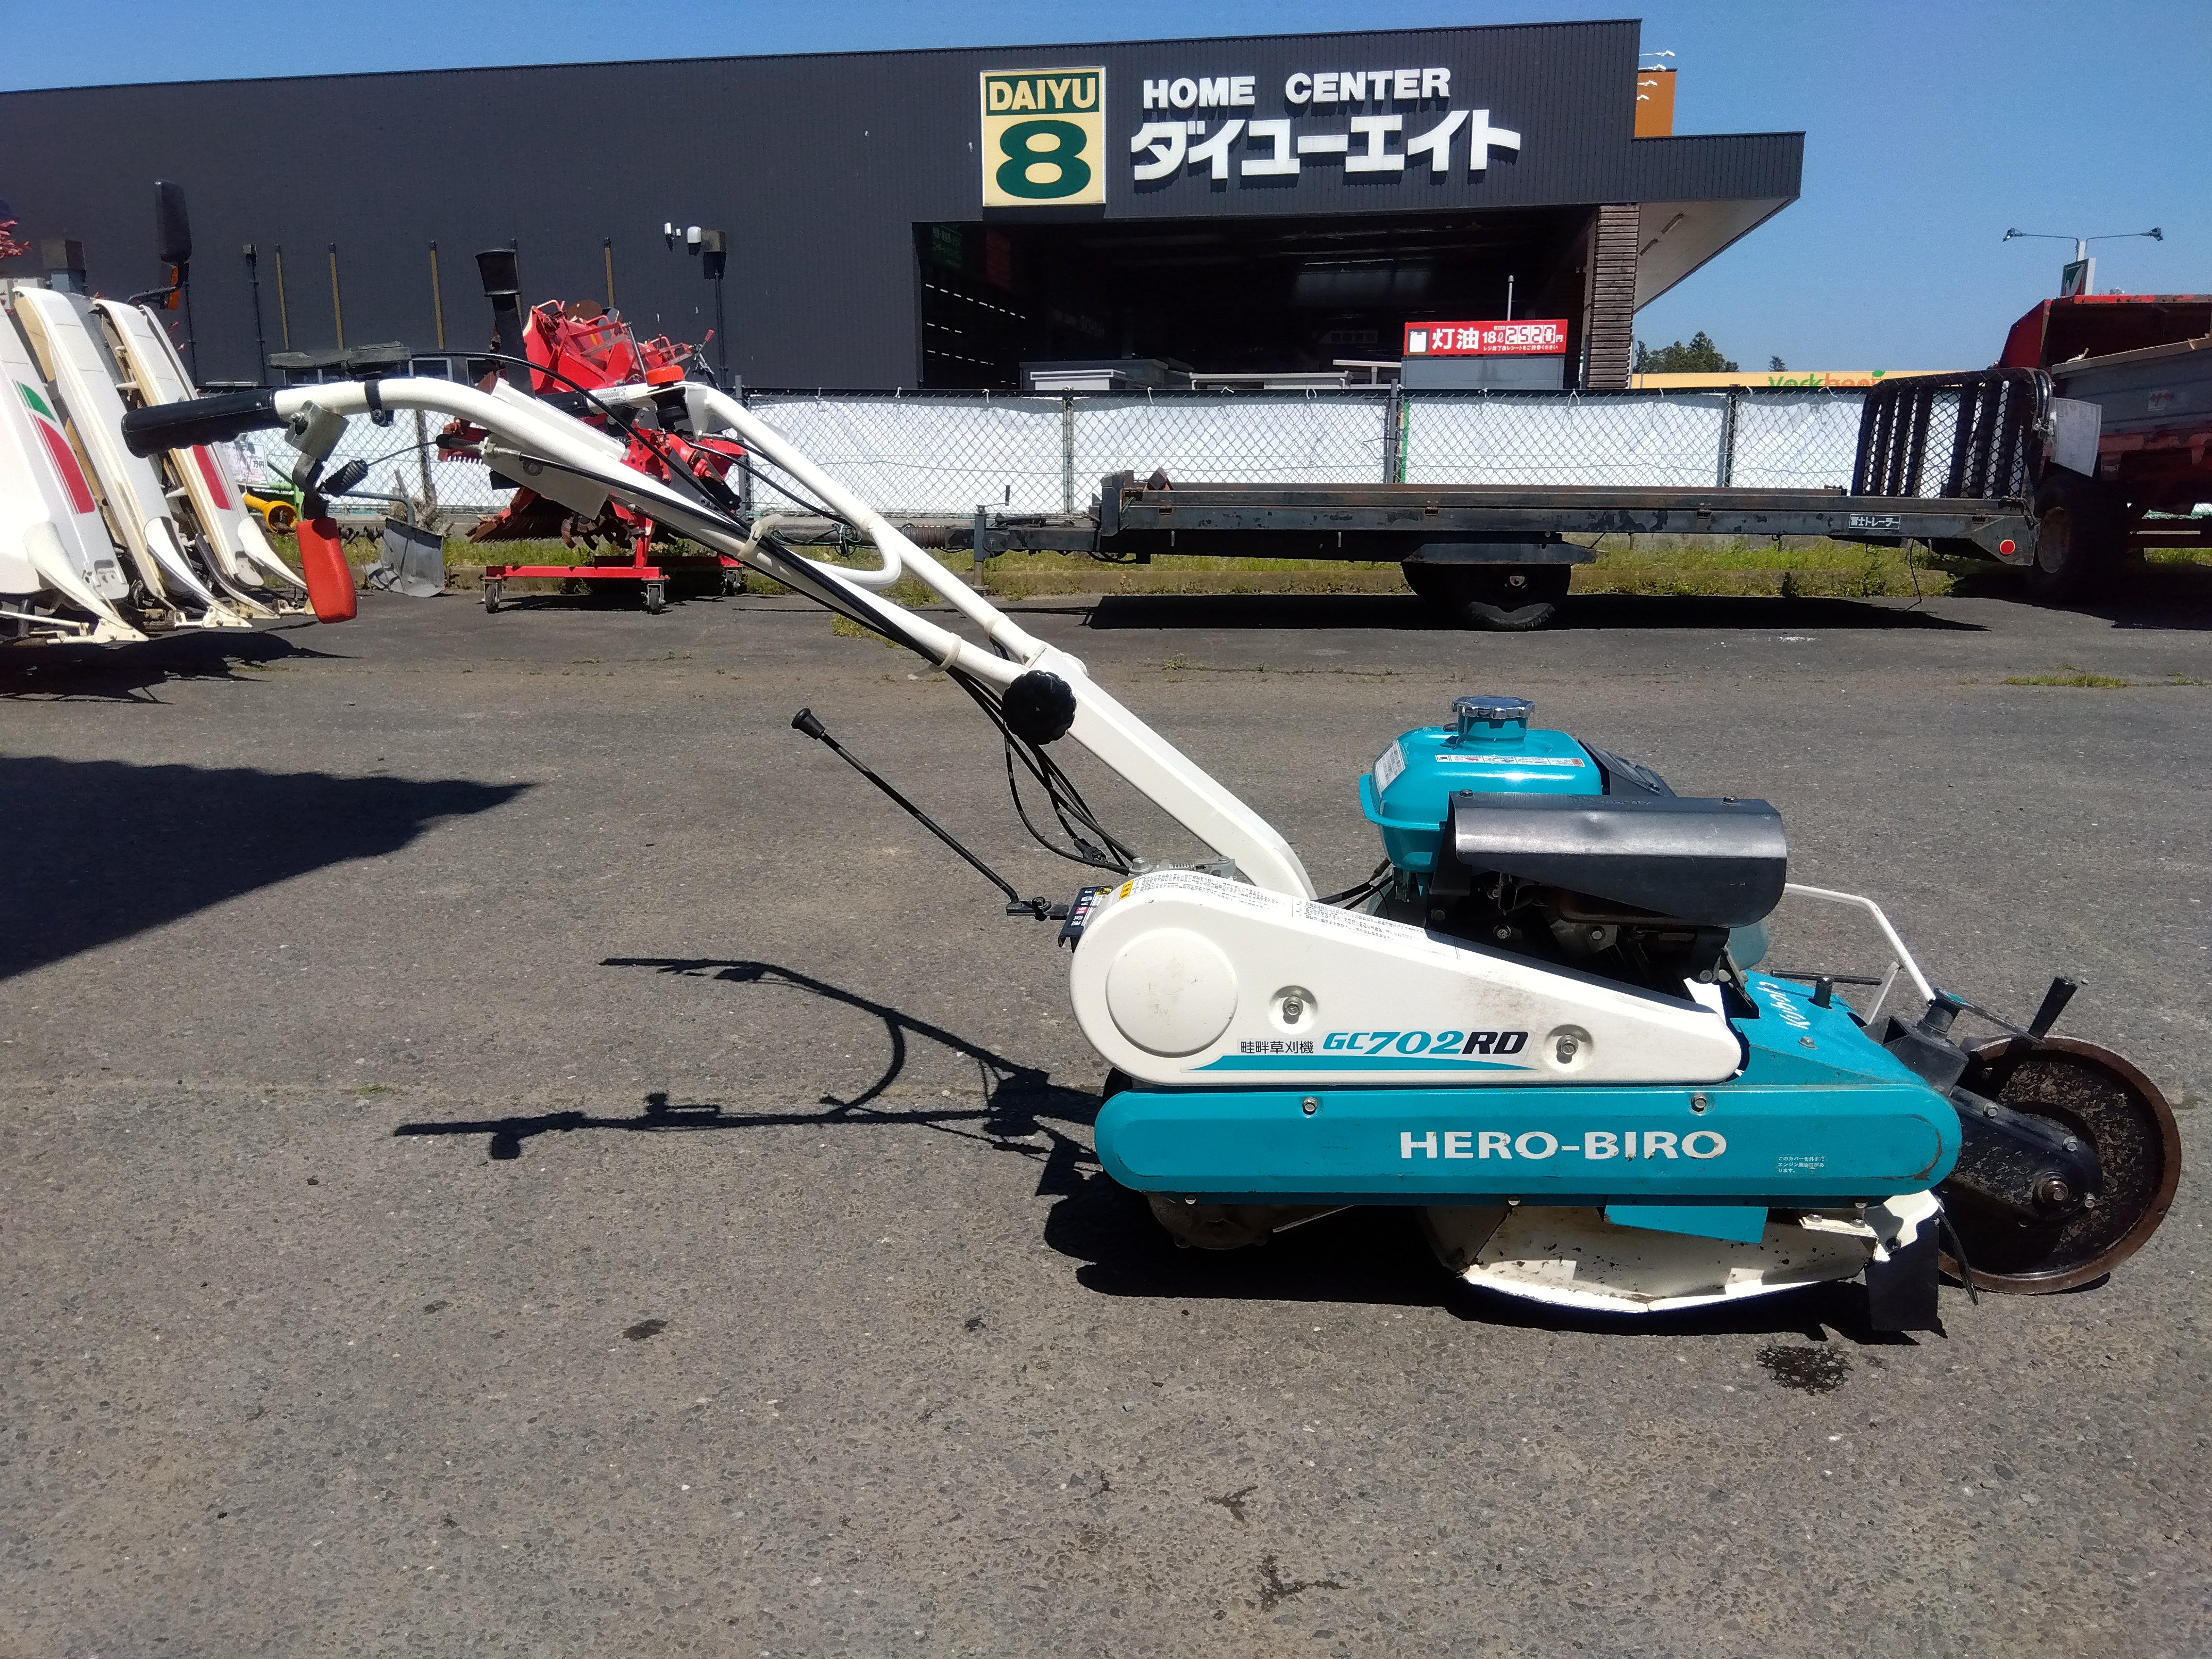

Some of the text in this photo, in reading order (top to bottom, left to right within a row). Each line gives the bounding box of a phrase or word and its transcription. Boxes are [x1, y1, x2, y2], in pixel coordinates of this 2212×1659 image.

[988, 78, 1096, 111] DAIYU
[1143, 68, 1451, 110] HOME CENTER
[996, 120, 1092, 199] 8
[1130, 109, 1521, 181] ダイユーエイト
[1431, 327, 1479, 350] 灯油
[1756, 982, 1811, 1030] Kubota
[1240, 1030, 1529, 1055] 畦畔草刈機 GC702RD
[1400, 1130, 1727, 1160] HERO-BIRO
